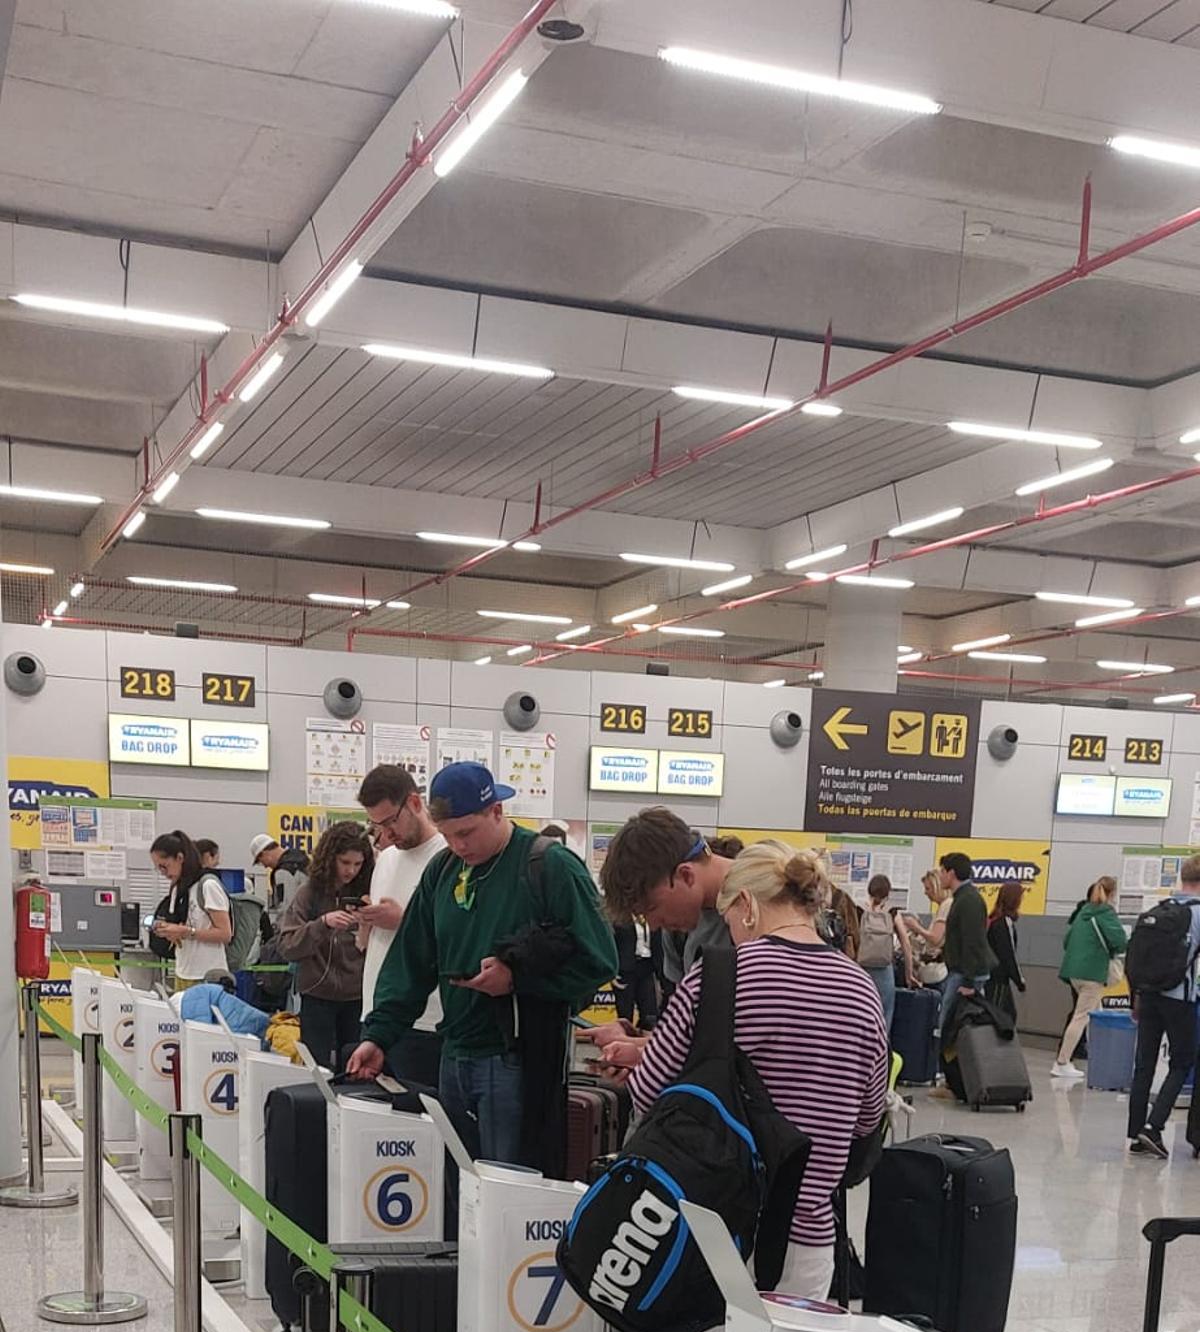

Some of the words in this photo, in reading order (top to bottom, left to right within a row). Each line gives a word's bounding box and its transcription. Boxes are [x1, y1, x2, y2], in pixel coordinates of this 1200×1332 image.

[124, 671, 171, 696] 218
[206, 677, 251, 702] 217
[603, 707, 643, 729] 216
[671, 711, 710, 734] 215
[121, 740, 144, 751] BAG
[147, 741, 178, 754] DROP
[1071, 738, 1104, 758] 214
[1126, 741, 1160, 761] 213
[600, 770, 619, 781] BAG
[622, 771, 647, 782] DROP
[668, 774, 686, 784] BAG
[688, 775, 713, 786] DROP
[820, 765, 845, 775] Totes
[848, 767, 861, 777] les
[863, 768, 891, 780] portes
[894, 770, 964, 783] d'embarcament
[820, 778, 830, 788] All
[832, 779, 866, 791] boarding
[868, 782, 889, 792] gates
[280, 814, 313, 832] CAN
[818, 804, 844, 814] Todas
[847, 805, 861, 815] las
[863, 807, 896, 819] puertas
[899, 808, 910, 817] de
[912, 809, 957, 822] embarque
[1109, 997, 1131, 1007] RYA
[161, 1043, 179, 1074] 3
[210, 1074, 239, 1111] 4
[376, 1140, 416, 1157] KIOSK
[376, 1173, 413, 1226] 6
[588, 1189, 680, 1314] arena
[527, 1266, 567, 1326] 7
